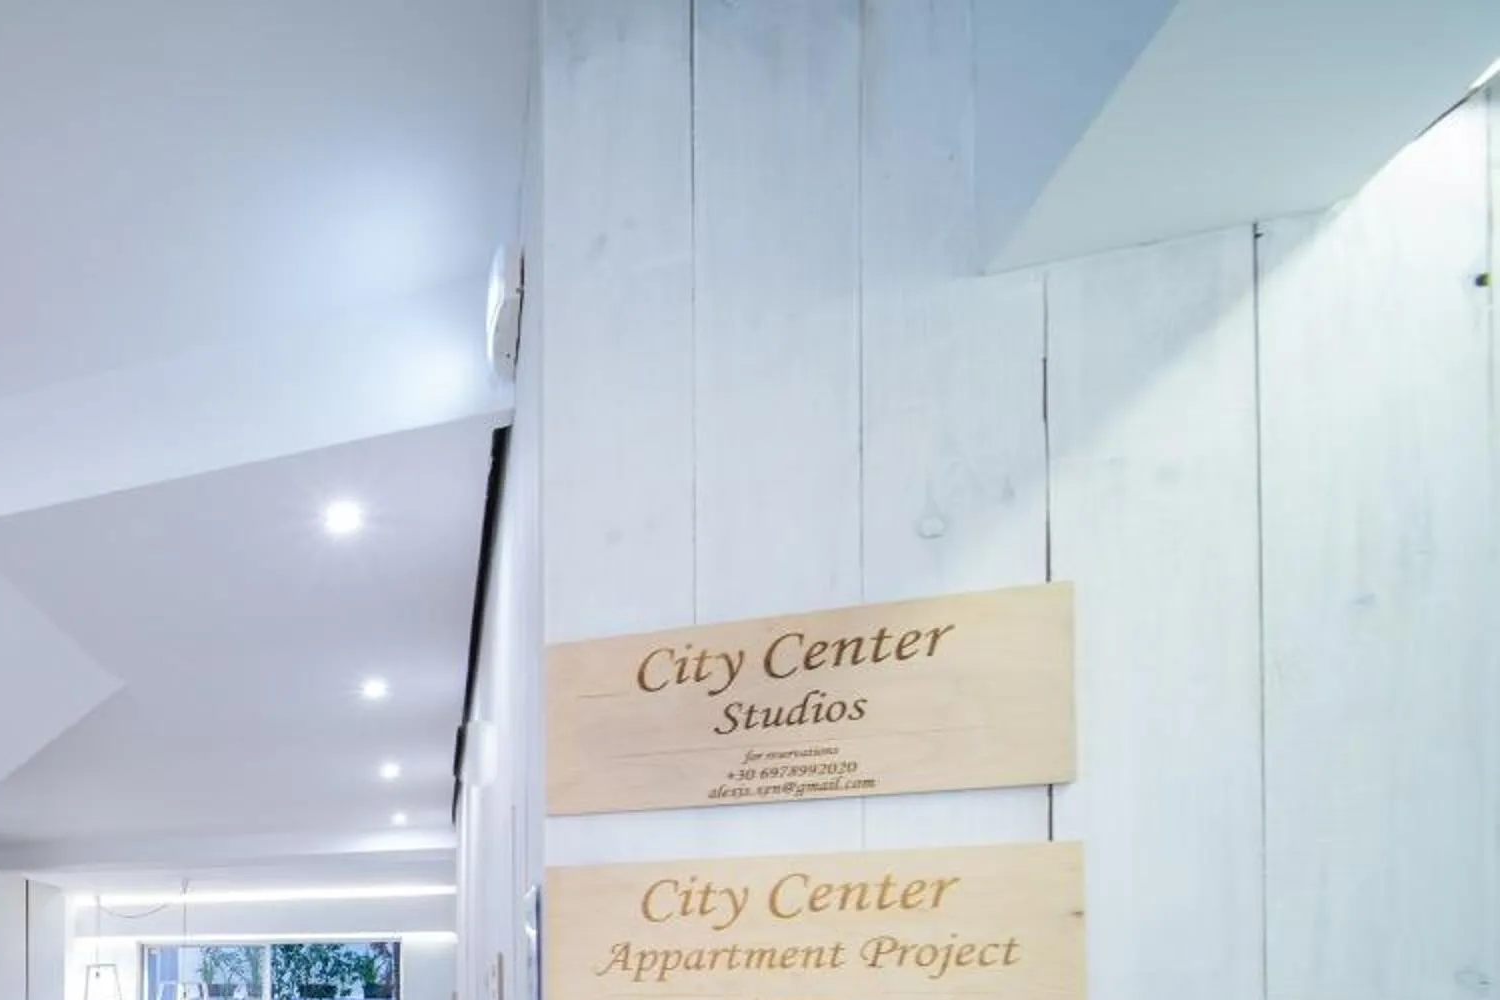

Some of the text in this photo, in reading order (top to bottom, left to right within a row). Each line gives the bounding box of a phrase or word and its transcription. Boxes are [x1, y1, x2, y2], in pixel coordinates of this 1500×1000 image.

[636, 623, 956, 697] City Center
[713, 688, 868, 736] Studios
[727, 767, 756, 781] +30
[741, 746, 840, 764] for reservations
[640, 871, 960, 930] City Center
[595, 932, 1022, 983] Appartment Project
